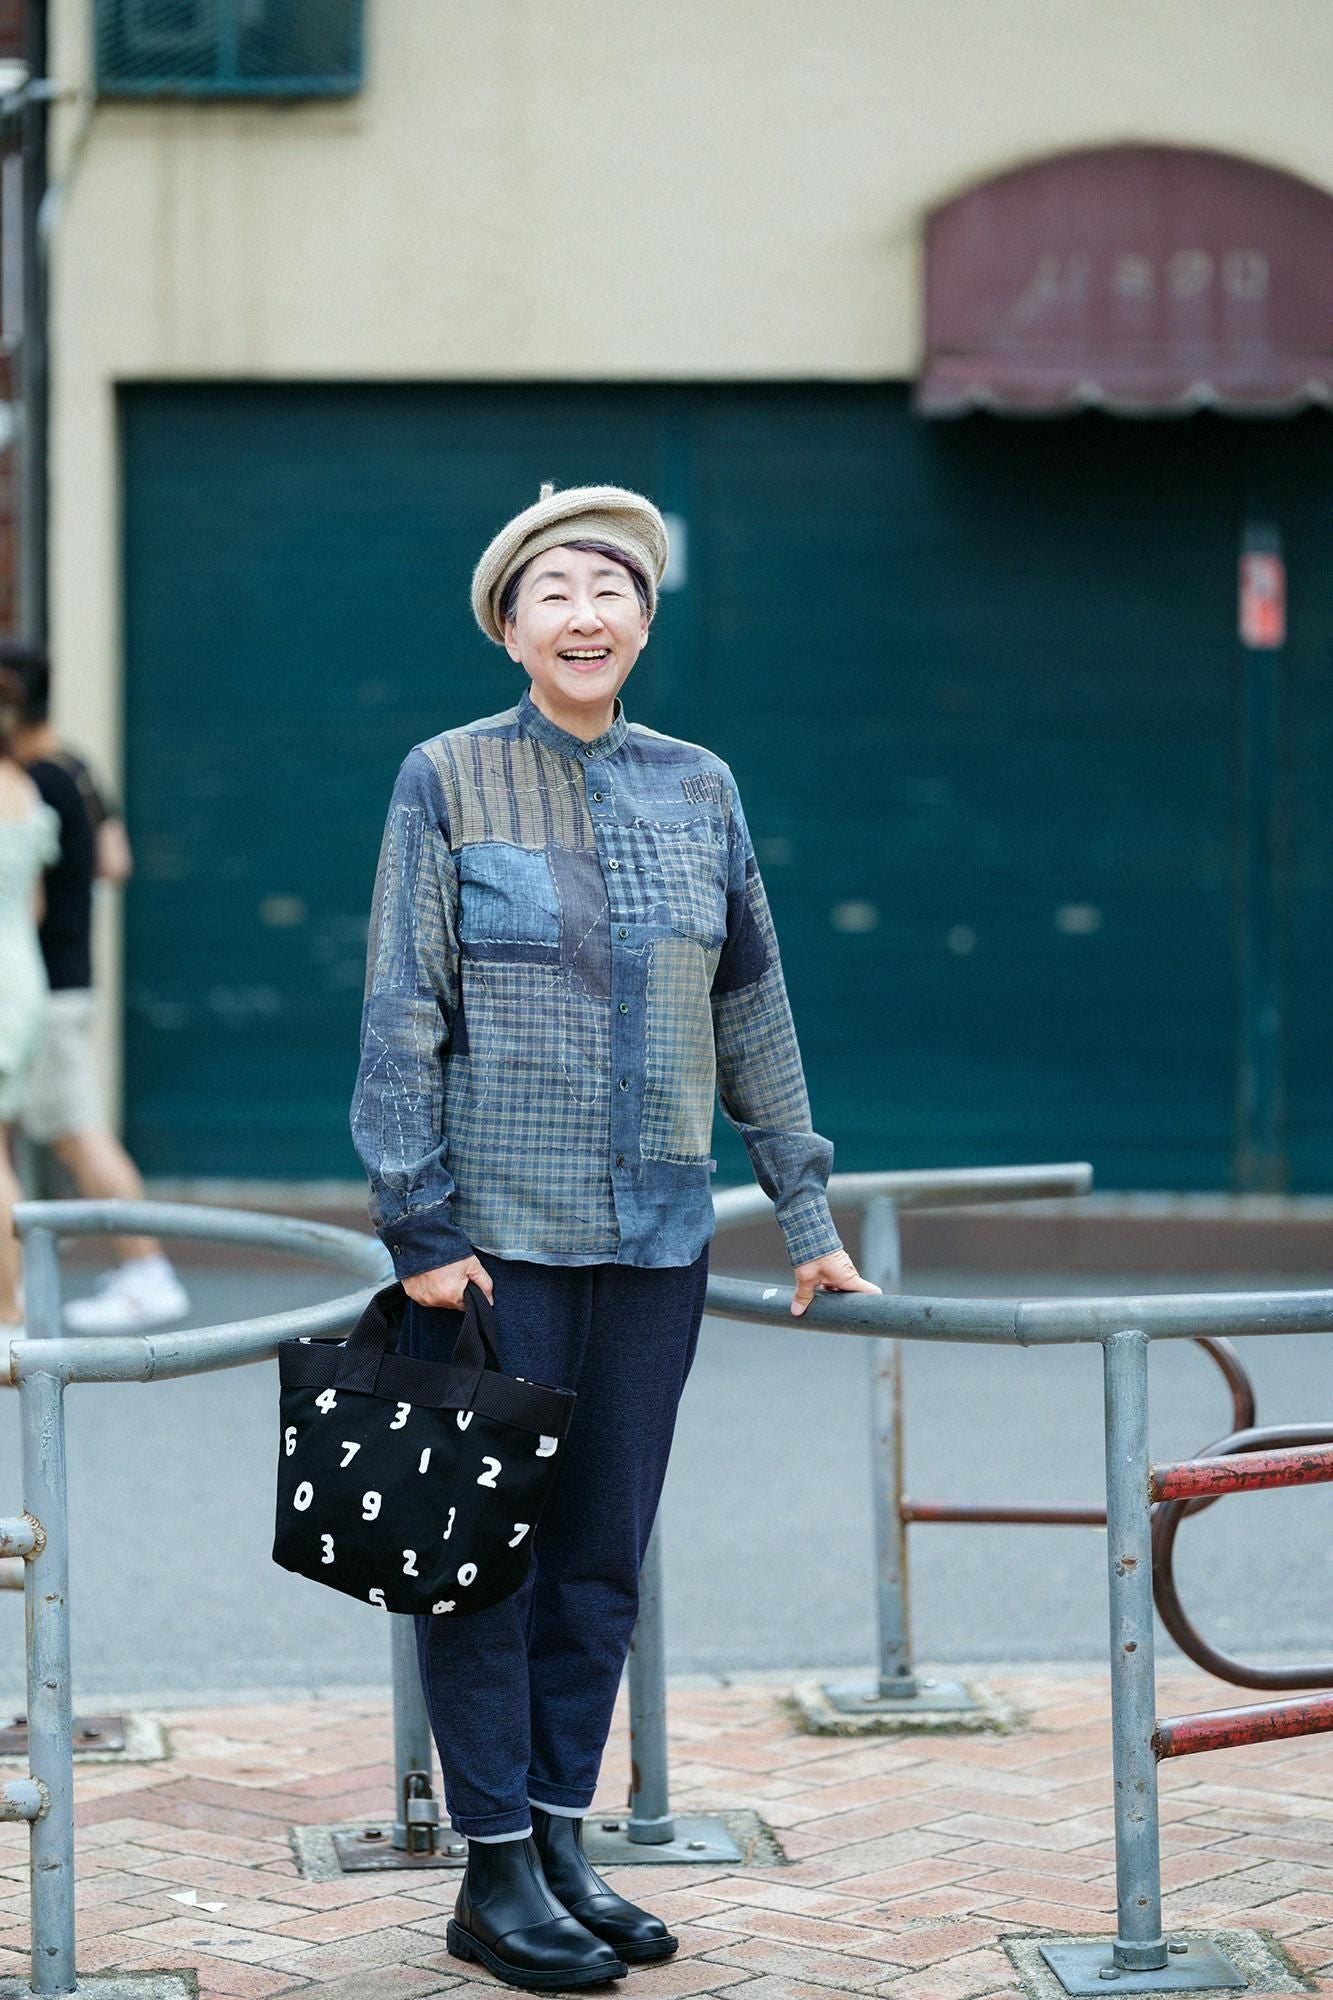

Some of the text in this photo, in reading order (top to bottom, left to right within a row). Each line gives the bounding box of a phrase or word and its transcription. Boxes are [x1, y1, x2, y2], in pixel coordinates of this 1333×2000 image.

[314, 1387, 338, 1415] 4
[389, 1401, 412, 1430] 3
[284, 1425, 298, 1457] 6
[339, 1440, 361, 1468] 7
[418, 1447, 432, 1474] 1
[476, 1455, 503, 1489] 2
[293, 1480, 314, 1512] 0
[361, 1490, 382, 1521] 9
[320, 1533, 335, 1565] 3
[507, 1522, 531, 1548] 7
[402, 1549, 419, 1577] 2
[456, 1562, 478, 1587] 0
